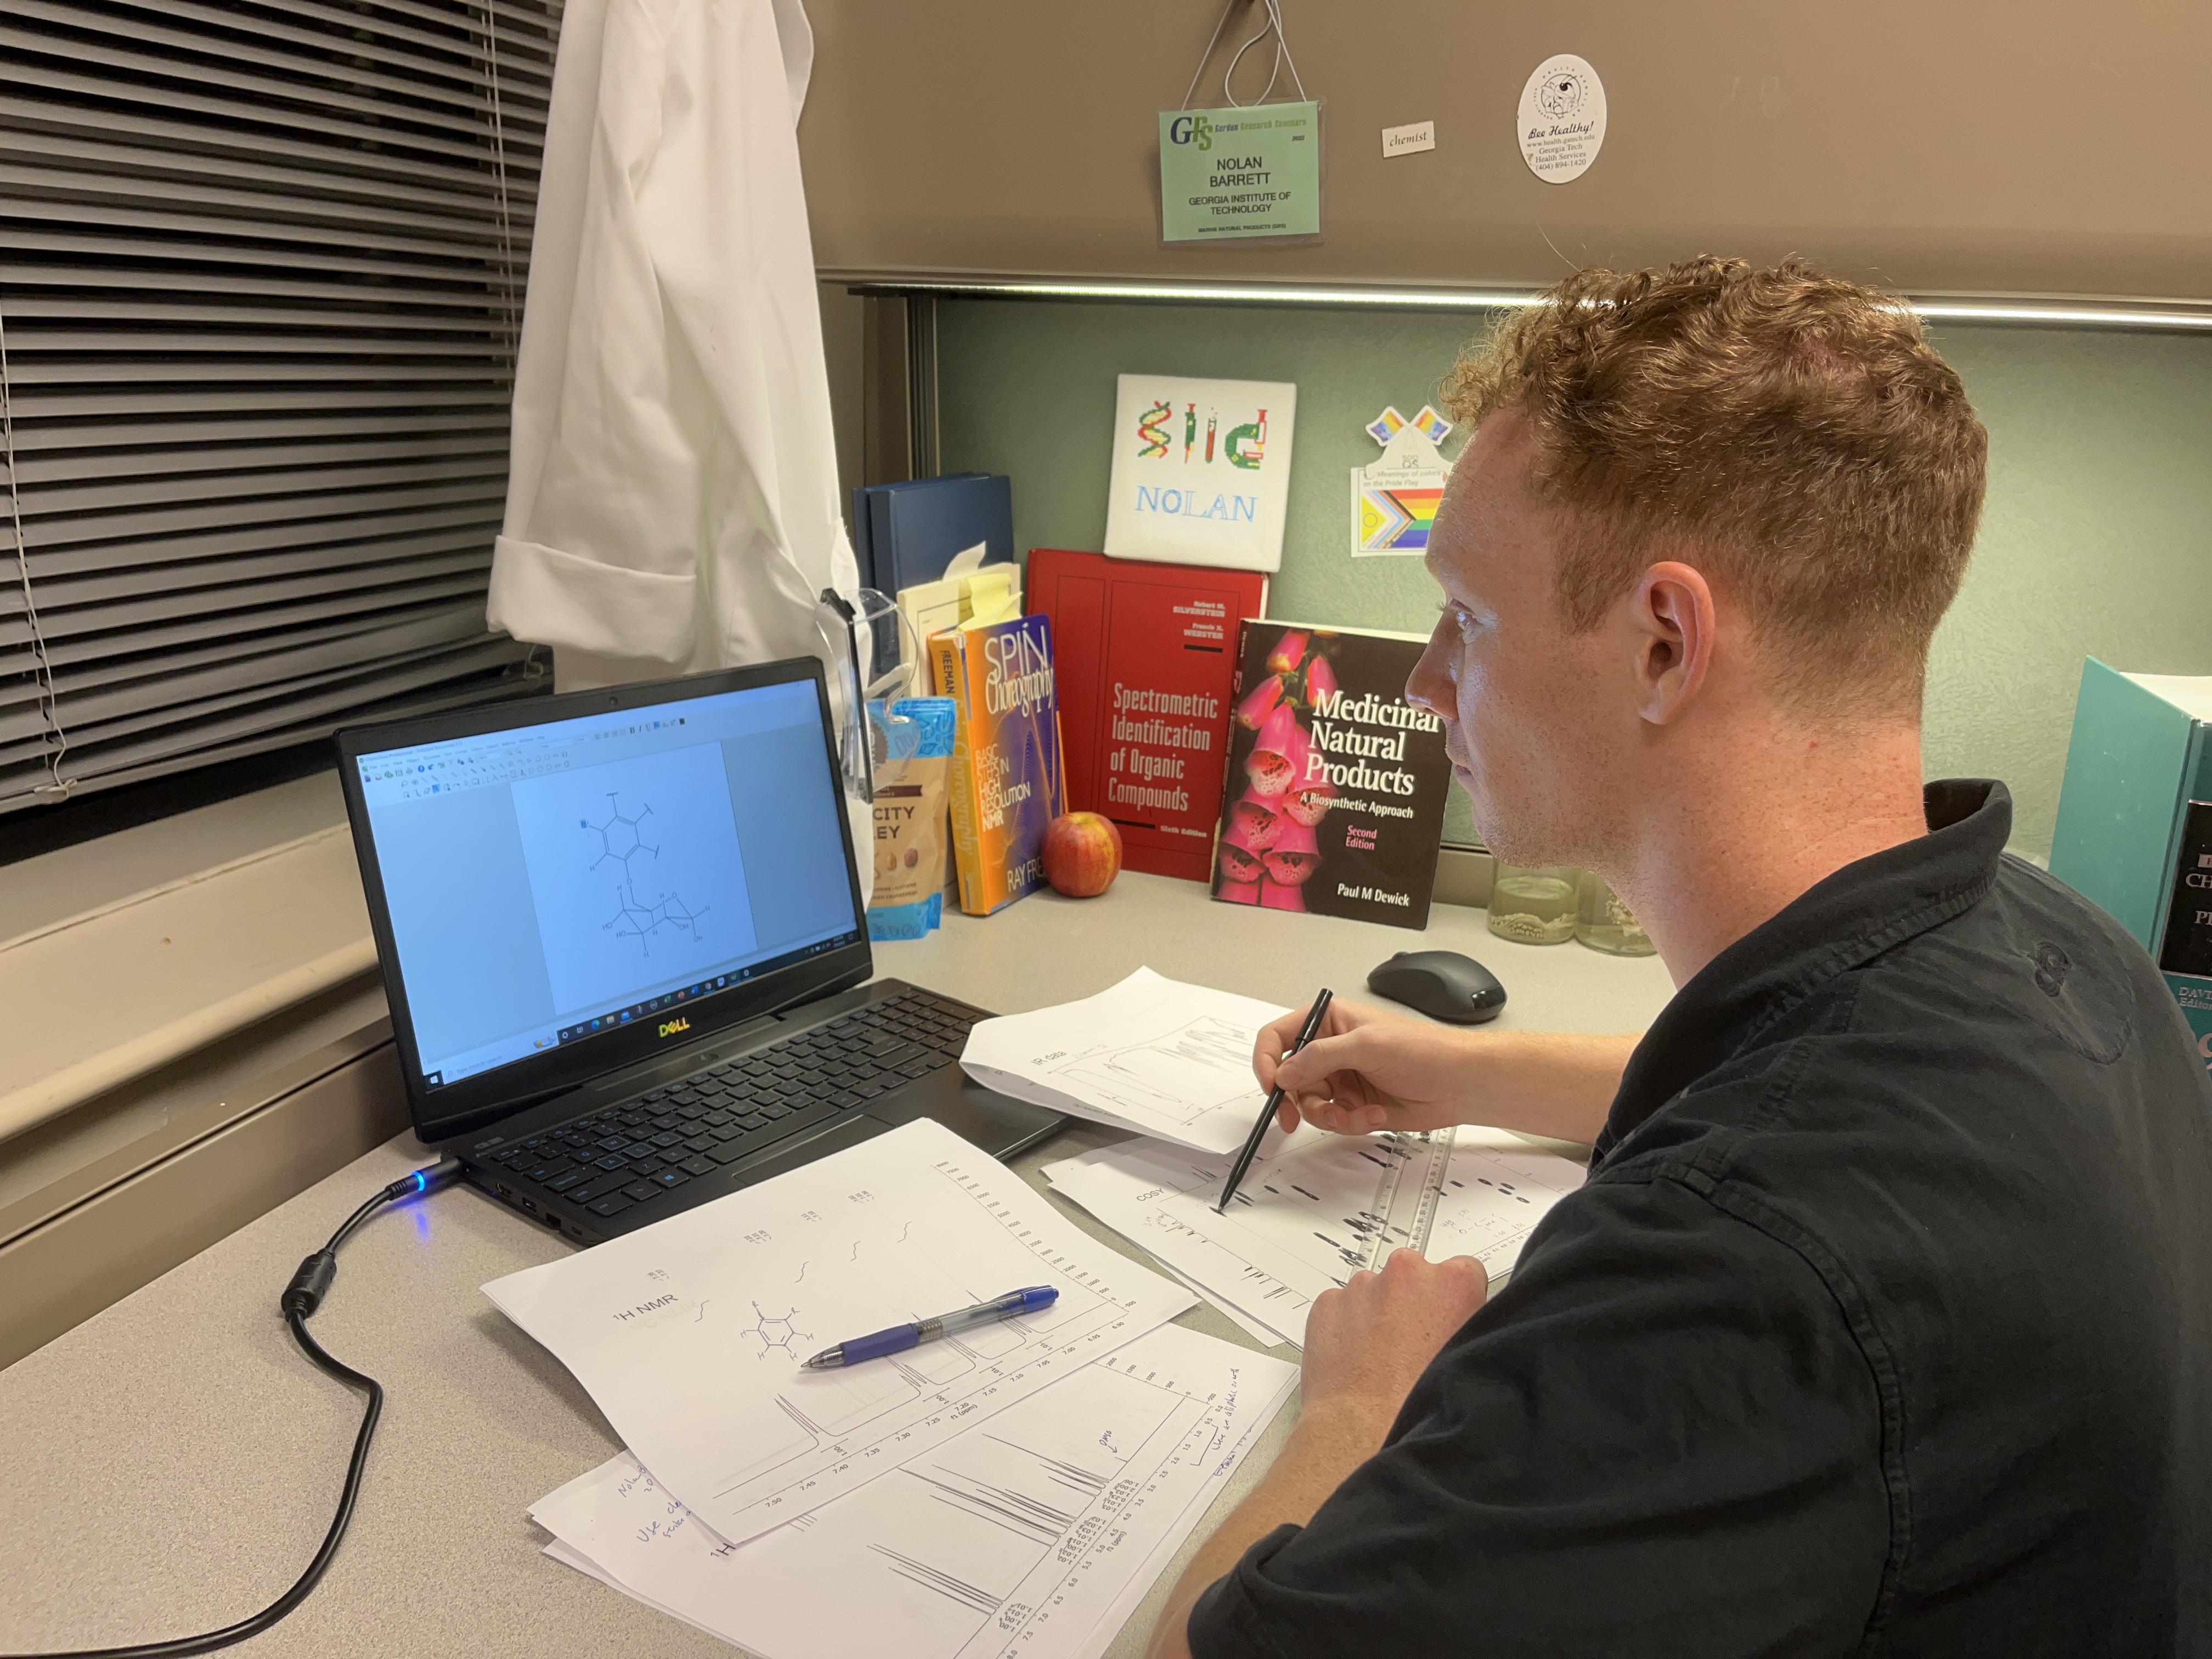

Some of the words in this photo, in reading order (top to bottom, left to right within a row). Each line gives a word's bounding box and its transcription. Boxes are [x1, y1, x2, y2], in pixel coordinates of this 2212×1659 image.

[1240, 120, 1272, 131] Research
[1528, 128, 1545, 139] Bee
[1549, 121, 1594, 136] Healthy!
[1389, 131, 1427, 147] chemist
[1527, 134, 1595, 147] www.health.gatech.edu
[1536, 155, 1557, 163] Health
[1559, 151, 1587, 160] Services
[1539, 146, 1565, 155] Georgia
[1217, 156, 1262, 171] NOLAN
[1536, 163, 1553, 171] (404)
[1555, 159, 1587, 168] 894-1420
[1210, 172, 1271, 187] BARRETT
[1189, 195, 1229, 206] GEORGIA
[1231, 193, 1276, 204] INSTITUTE
[1279, 191, 1291, 200] OF
[1210, 204, 1272, 215] TECHNOLOGY
[1377, 470, 1409, 478] Meanings
[1134, 485, 1259, 522] NOLAN
[1173, 606, 1225, 617] SILVERSTEIN
[1183, 629, 1223, 639] WEBSTER
[984, 622, 1049, 681] SPIN
[940, 650, 955, 694] FREEMAN
[986, 667, 1054, 718] Choreography
[1114, 682, 1218, 719] Spectrometric
[1112, 715, 1210, 751] Identification
[1307, 720, 1404, 761] Natural
[975, 743, 999, 766] BASIC
[998, 757, 1010, 777] IN
[1110, 748, 1126, 771] of
[1130, 749, 1184, 780] Organic
[1304, 753, 1414, 795] Products
[978, 778, 1001, 801] HIGH
[1108, 778, 1188, 811] Compounds
[980, 781, 1031, 817] RESOLUTION
[1300, 793, 1308, 803] A
[1310, 793, 1367, 812] Biosynthetic
[1368, 802, 1413, 820] Approach
[981, 810, 1005, 833] NMR
[873, 826, 901, 839] EY
[1160, 825, 1179, 834] Sixth
[1181, 827, 1206, 838] Edition
[1347, 825, 1377, 839] Second
[1345, 836, 1375, 851] Edition
[1007, 864, 1026, 893] RAY
[1338, 884, 1359, 900] Paul
[1361, 887, 1372, 900] M
[1374, 889, 1410, 907] Dewick
[659, 1016, 690, 1037] DELL
[1030, 1057, 1048, 1065] IR
[1045, 1050, 1067, 1060] data
[1136, 1188, 1165, 1201] COSY
[636, 1294, 679, 1314] NMR
[1036, 1359, 1050, 1368] 7.05
[1010, 1373, 1024, 1382] 7.10
[983, 1387, 997, 1397] 7.15
[954, 1402, 969, 1412] 7.20
[958, 1404, 978, 1416] (ppm)
[926, 1417, 940, 1426] 7.25
[895, 1432, 911, 1442] 7.30
[865, 1447, 881, 1458] 7.35
[1171, 1457, 1180, 1465] 2.0
[832, 1464, 849, 1475] 7.40
[1159, 1470, 1168, 1479] 2.5
[800, 1481, 816, 1491] 7.45
[765, 1497, 782, 1508] 7.50
[1135, 1498, 1144, 1506] 3.5
[636, 1521, 661, 1542] Use
[1110, 1528, 1119, 1537] 4.5
[1111, 1531, 1127, 1546] (ppm)
[1096, 1544, 1106, 1553] 5.0
[1082, 1561, 1092, 1570] 5.5
[1068, 1578, 1077, 1587] 6.0
[1054, 1595, 1063, 1605] 6.5
[1038, 1613, 1048, 1622] 7.0
[1022, 1630, 1033, 1640] 7.5
